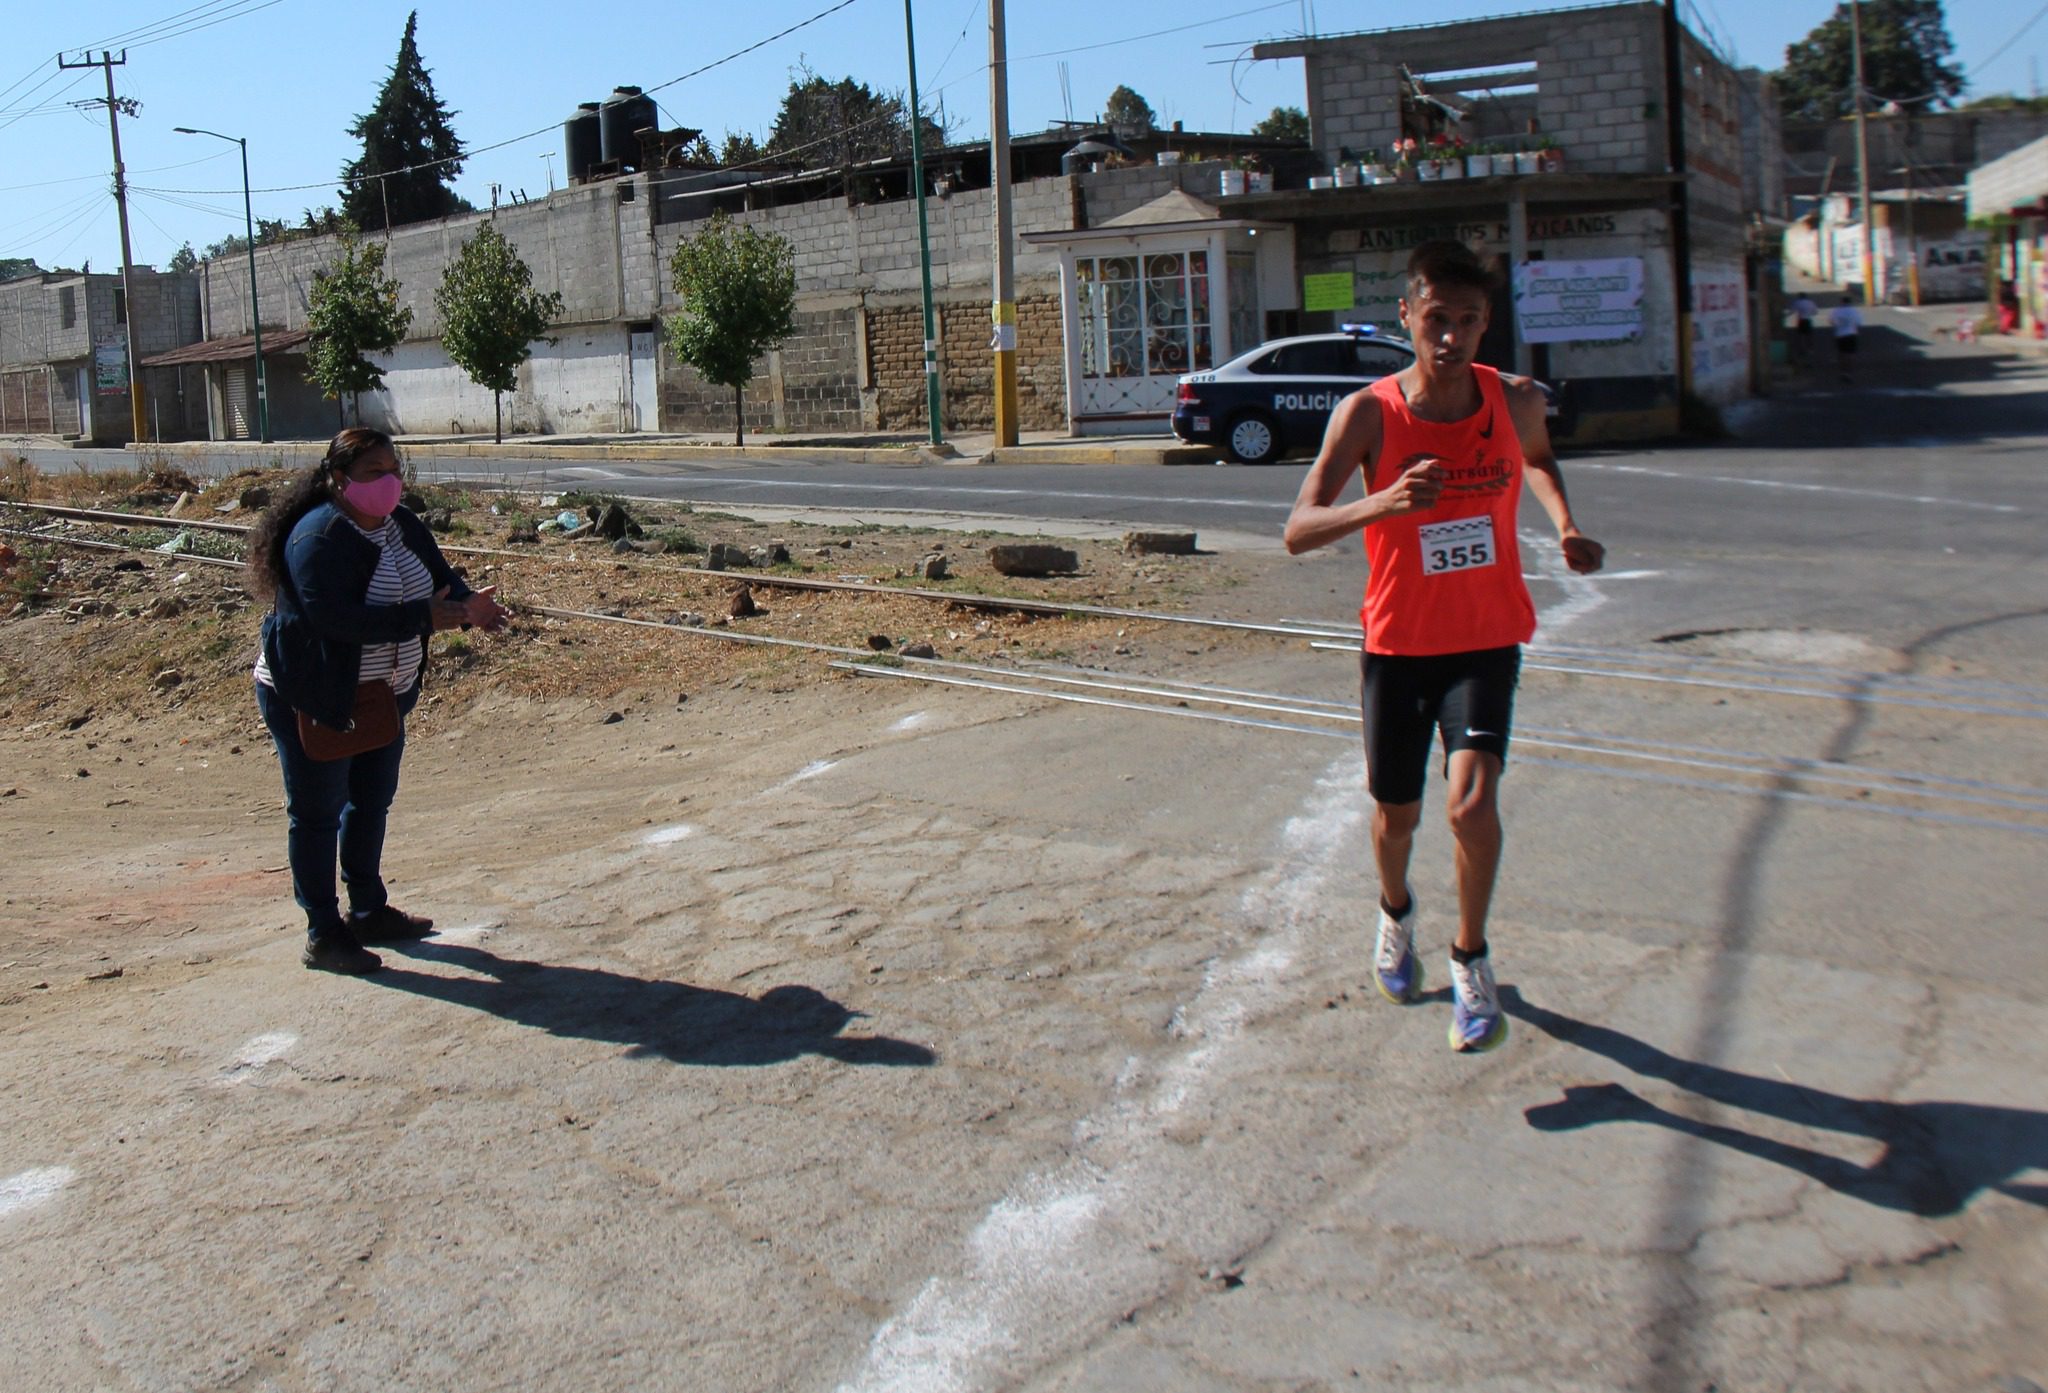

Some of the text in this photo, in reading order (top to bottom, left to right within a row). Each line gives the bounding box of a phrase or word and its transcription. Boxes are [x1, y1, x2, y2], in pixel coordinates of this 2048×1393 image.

[1497, 215, 1617, 241] MXICANOS
[1190, 374, 1216, 383] 018
[1431, 543, 1488, 571] 355
